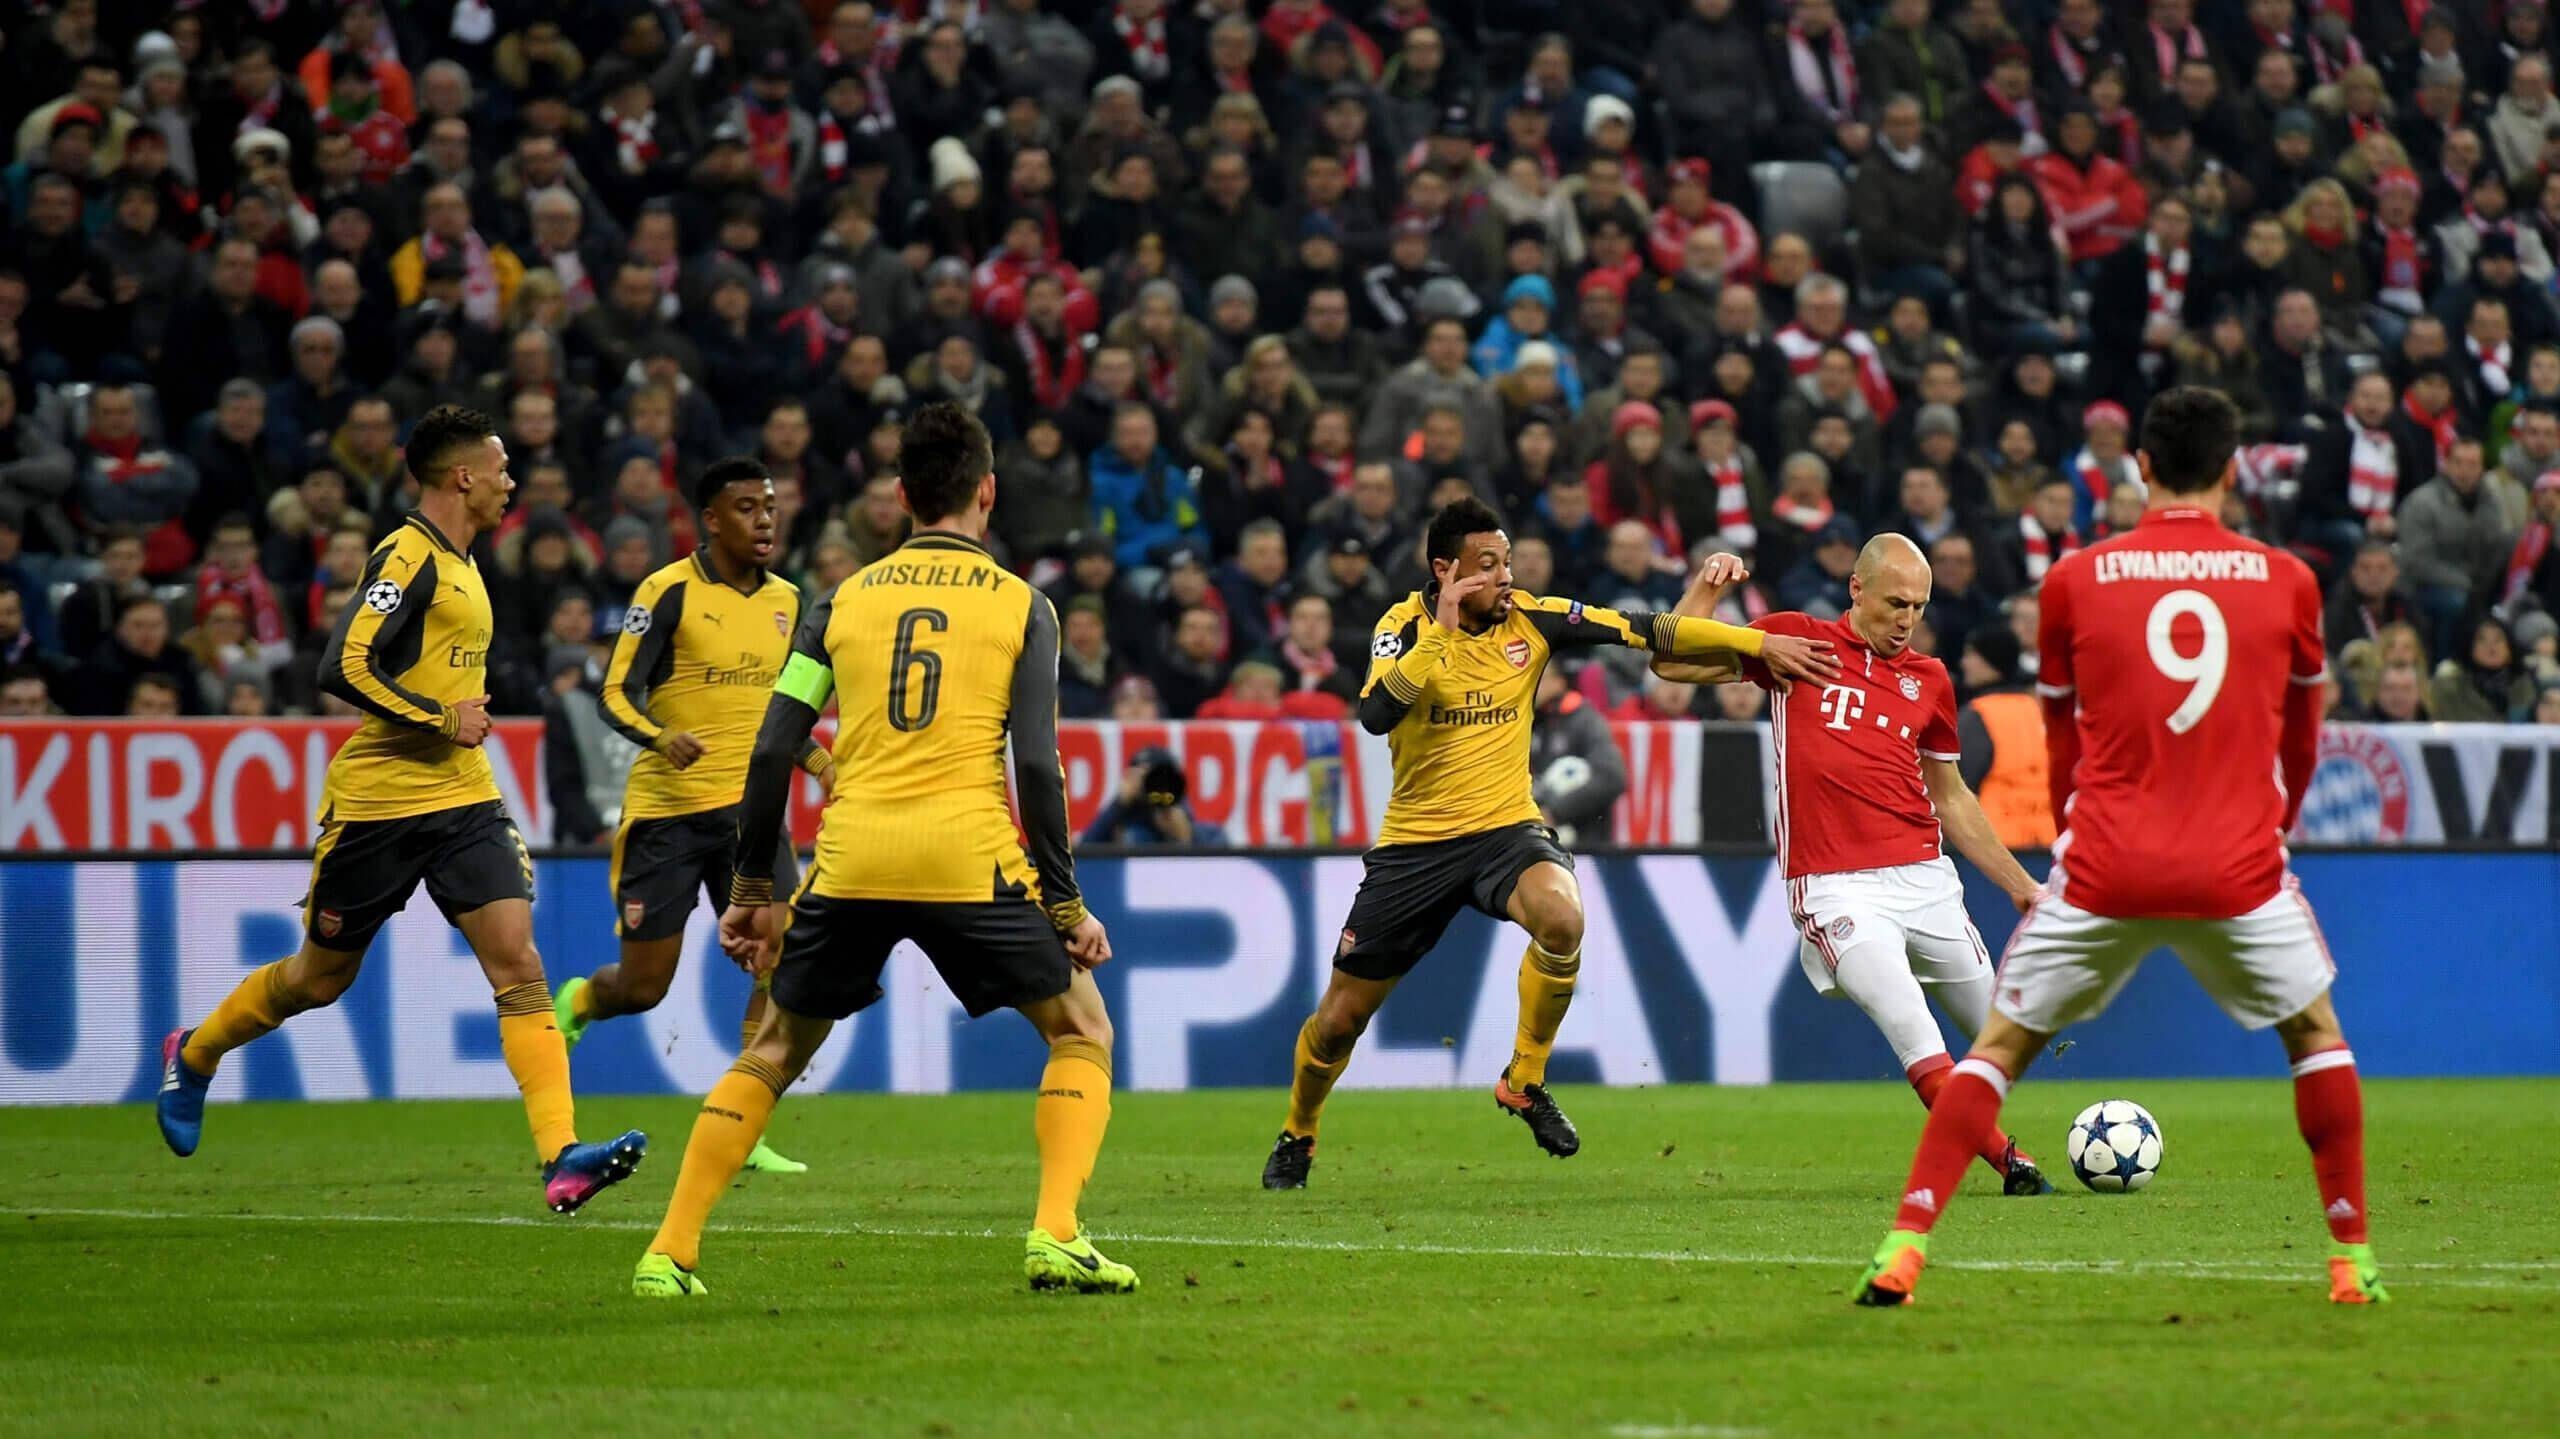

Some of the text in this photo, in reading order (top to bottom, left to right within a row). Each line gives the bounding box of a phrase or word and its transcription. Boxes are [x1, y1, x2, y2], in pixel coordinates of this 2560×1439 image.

[861, 564, 1008, 592] KOSCIELNY
[2095, 550, 2270, 583] LEWANDOWSKI
[887, 606, 949, 733] 6
[2145, 588, 2230, 735] 9
[1465, 691, 1493, 706] Fly
[1429, 704, 1519, 727] Emirates
[1124, 855, 1802, 1092] PLAY
